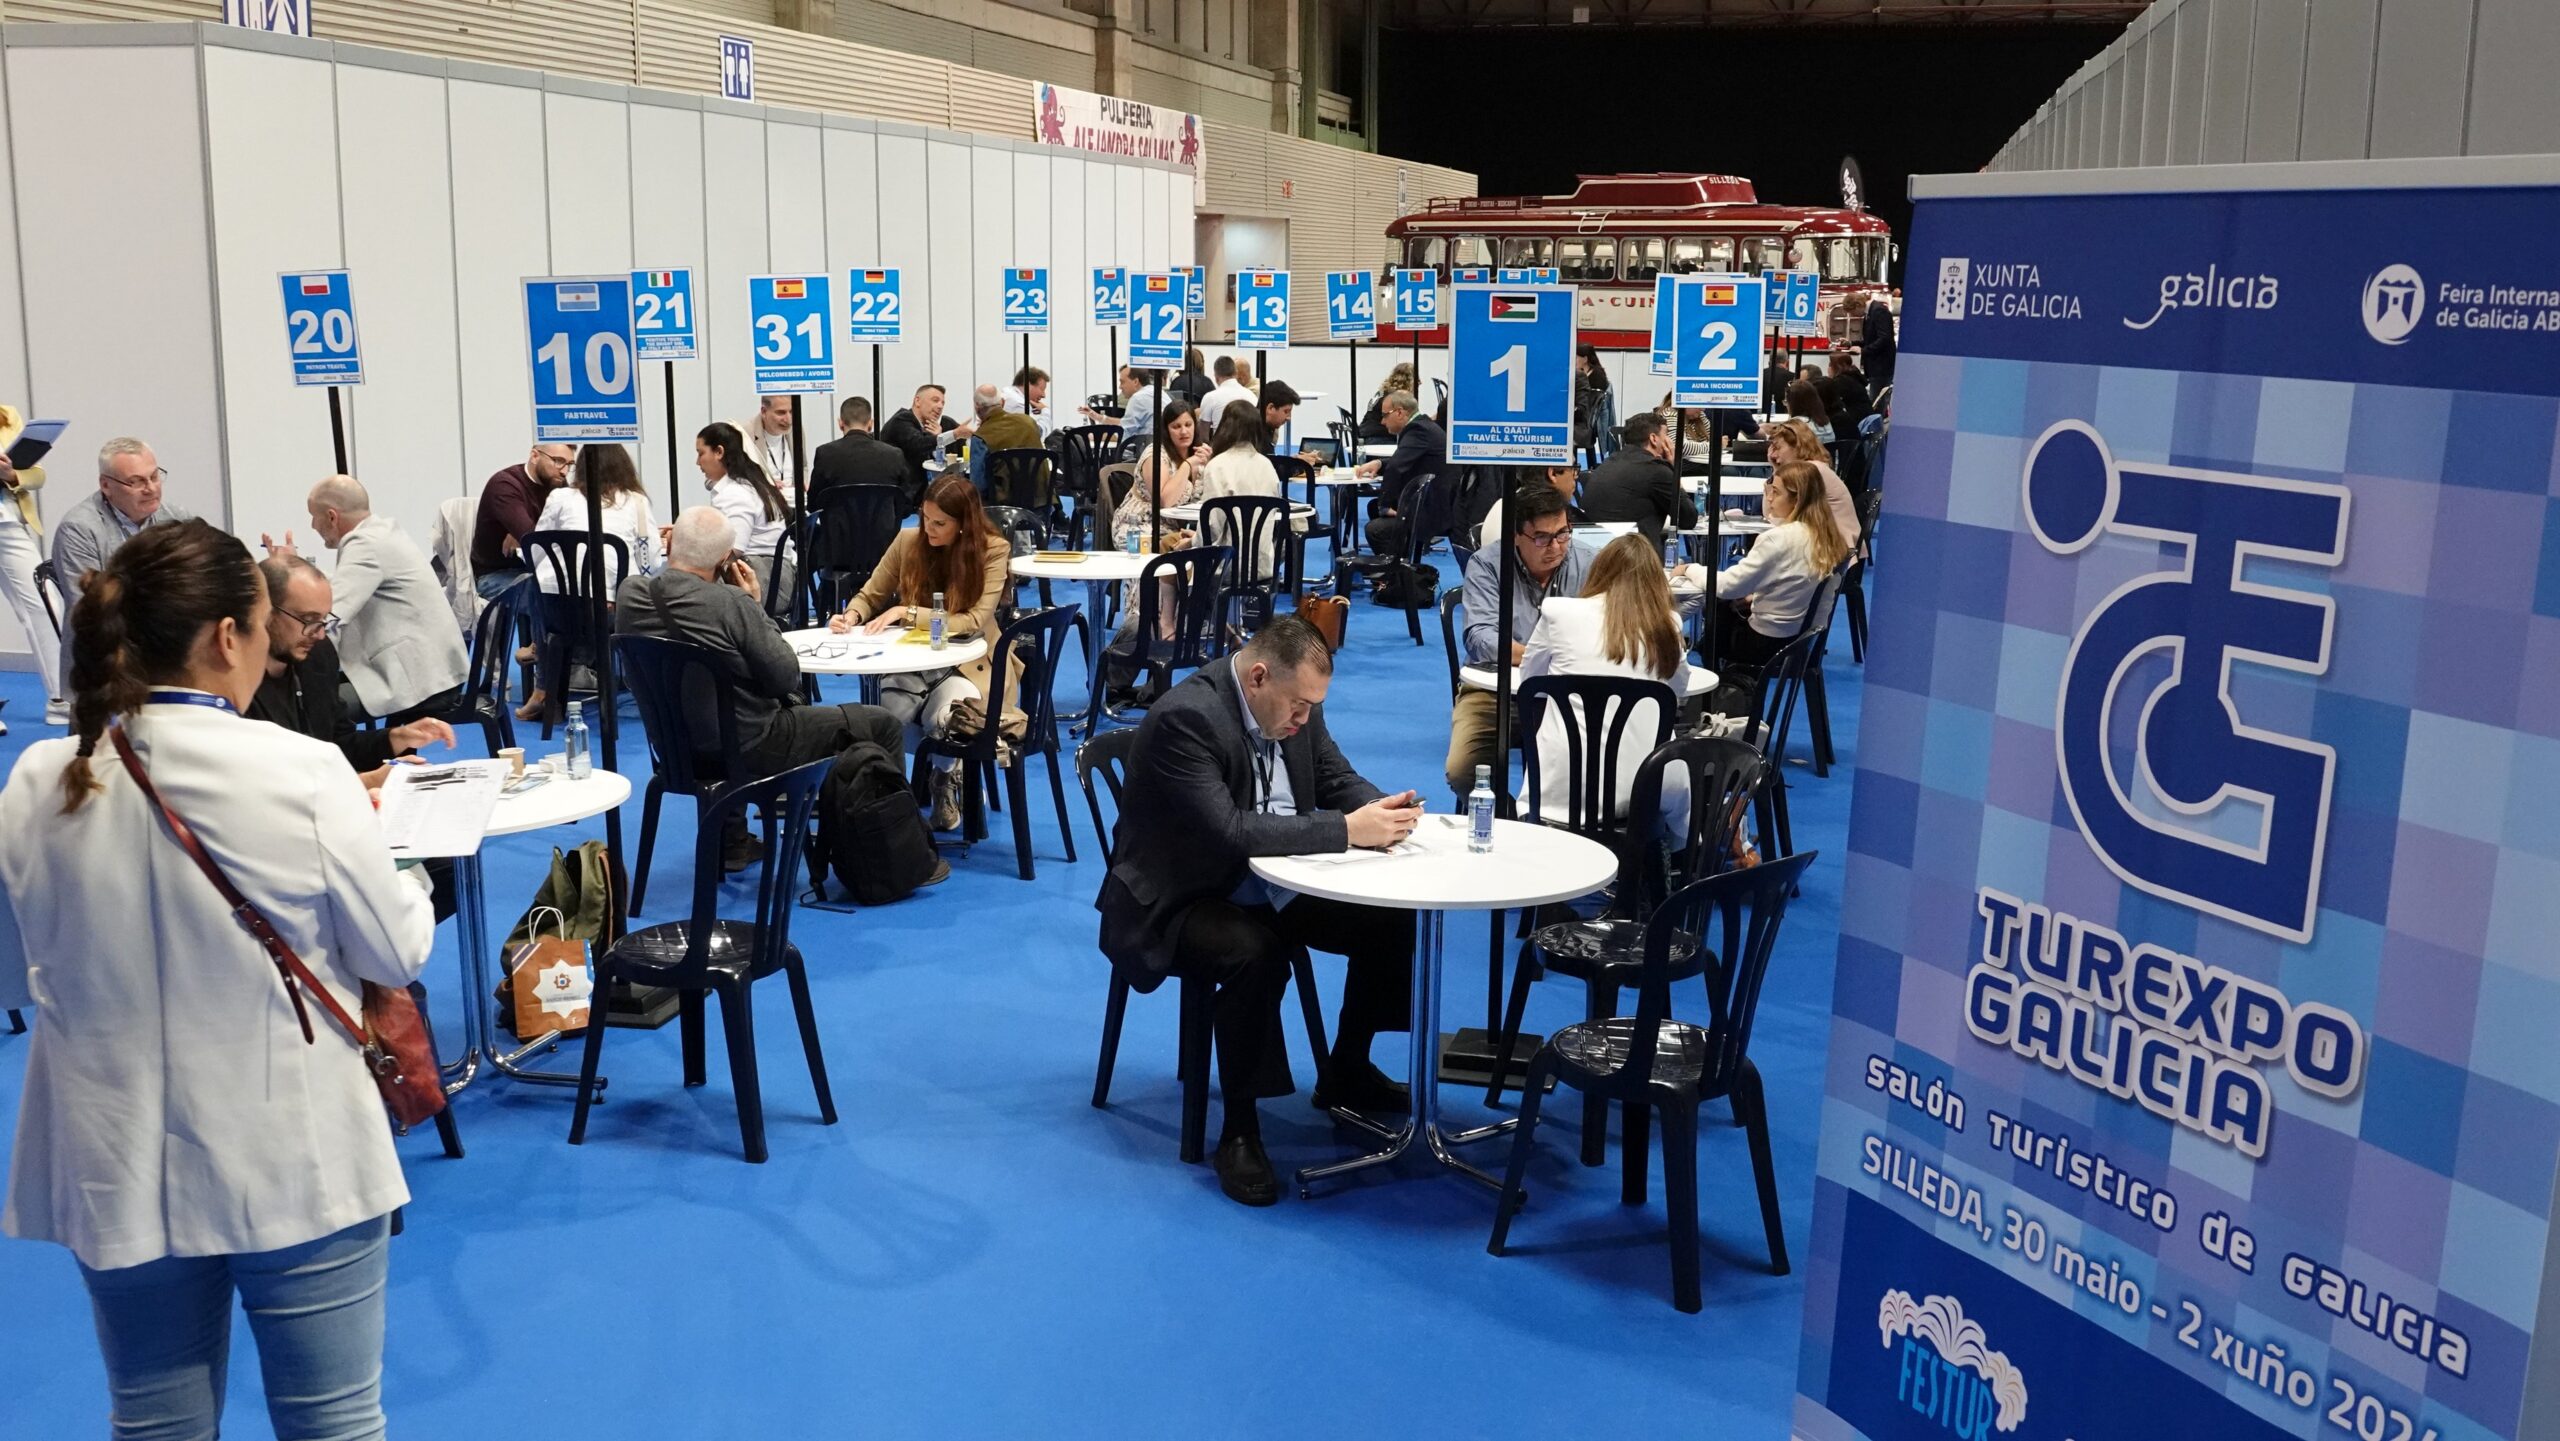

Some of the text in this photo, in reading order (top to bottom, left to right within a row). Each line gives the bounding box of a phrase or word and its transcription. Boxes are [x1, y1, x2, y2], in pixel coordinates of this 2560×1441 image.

[1100, 96, 1153, 130] PULPERIA
[1974, 264, 2041, 288] XUNTA
[852, 291, 899, 322] 22
[1005, 288, 1047, 314] 23
[1095, 285, 1126, 309] 24
[1188, 283, 1203, 304] 5
[1331, 291, 1373, 320] 14
[1399, 288, 1435, 313] 15
[1771, 288, 1785, 310] 7
[1794, 292, 1808, 318] 6
[1971, 293, 2082, 320] DE GALICIA
[2123, 263, 2279, 330] galicia
[2439, 283, 2560, 307] Feira Interna
[635, 292, 686, 329] 21
[1133, 303, 1183, 341] 12
[1241, 295, 1286, 328] 13
[2436, 307, 2460, 328] de
[2464, 308, 2529, 330] Galicia
[289, 308, 354, 354] 20
[755, 312, 824, 361] 31
[1698, 321, 1737, 371] 2
[537, 331, 631, 396] 10
[1489, 344, 1528, 413] 1
[1467, 434, 1553, 443] TRAVEL & TOURISM
[1490, 426, 1531, 434] AL QAATI
[1495, 447, 1525, 457] galicia
[1981, 889, 2360, 1095] TUREXPO
[1967, 965, 2269, 1155] GALICIA
[2202, 1214, 2255, 1272] de
[1863, 1136, 1992, 1242] SILLEDA,
[2003, 1209, 2045, 1262] 30
[2053, 1243, 2141, 1314] maio
[2152, 1304, 2168, 1319] -
[2178, 1301, 2202, 1349] 2
[2211, 1326, 2315, 1407] xuño
[1899, 1338, 1993, 1441] FESTUR
